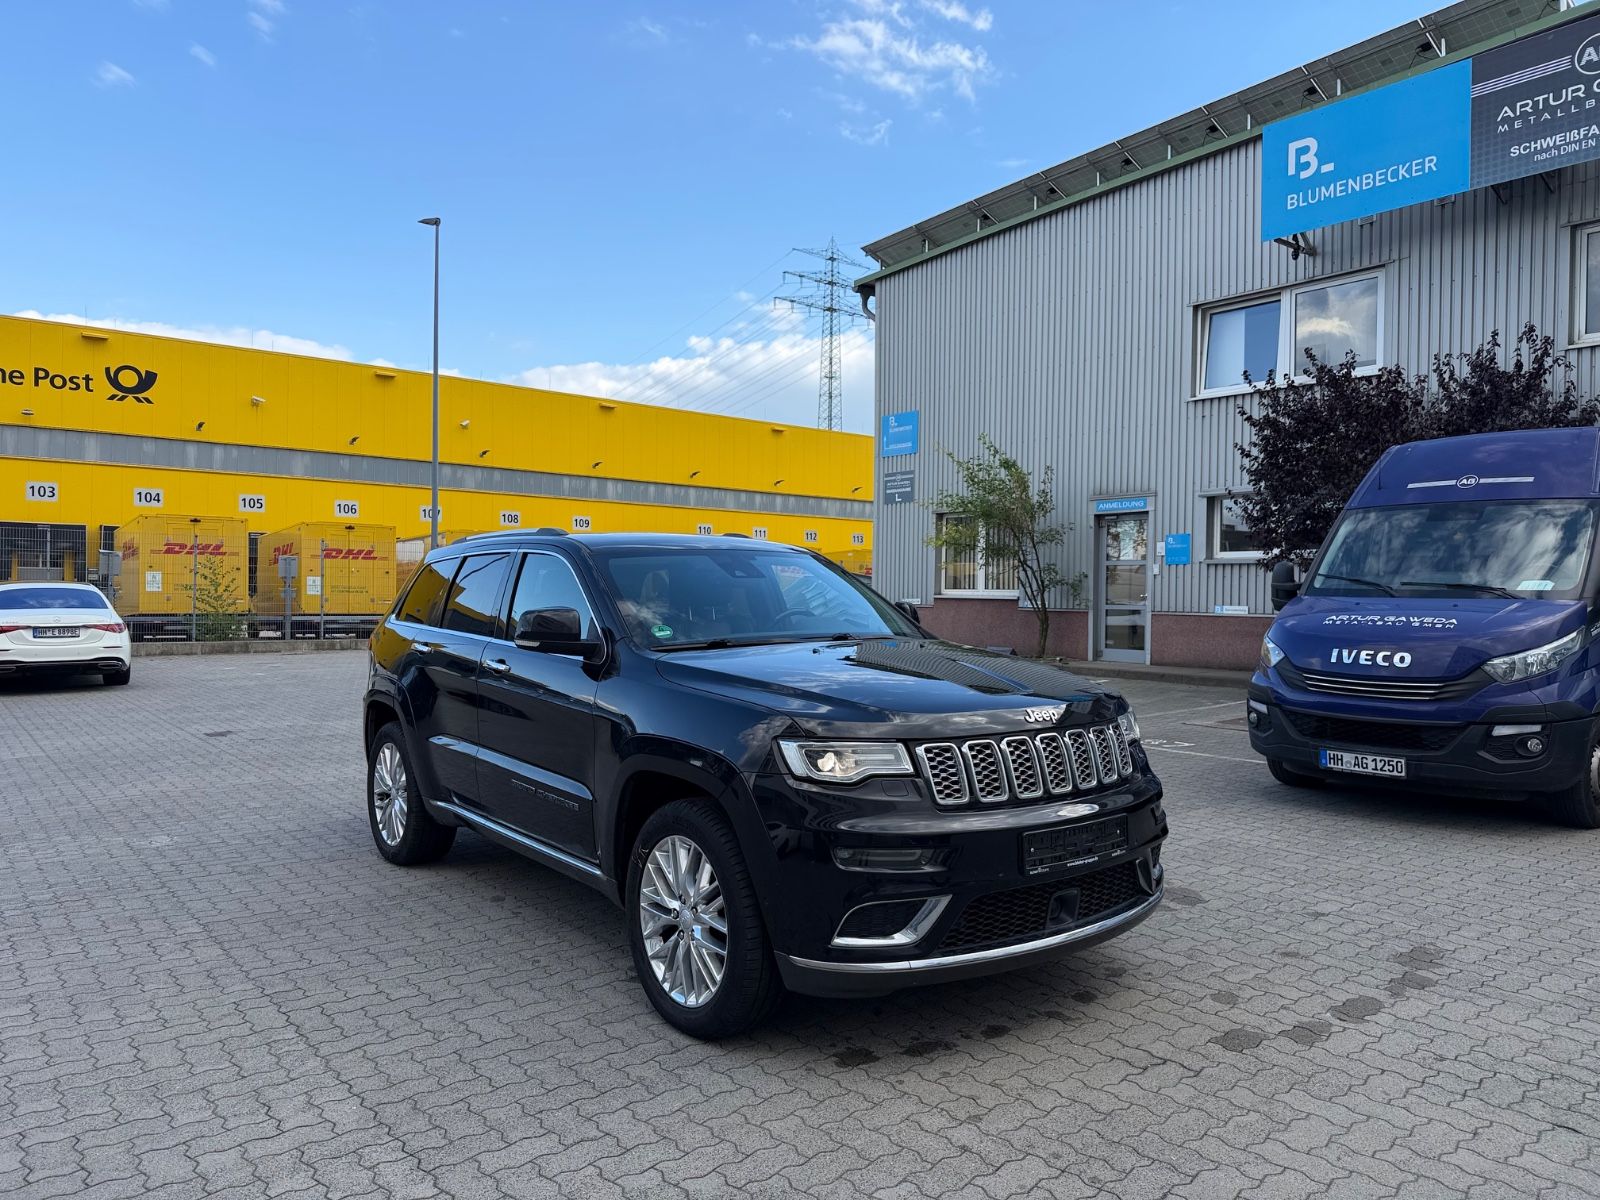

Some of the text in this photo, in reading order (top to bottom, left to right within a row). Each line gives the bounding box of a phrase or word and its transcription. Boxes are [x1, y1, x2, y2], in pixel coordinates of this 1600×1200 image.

[1580, 46, 1600, 67] A
[1496, 84, 1586, 122] ARTUR
[1497, 99, 1596, 134] METALLB
[1534, 138, 1596, 162] nach DIN EN
[1286, 155, 1438, 210] BLUMENBECKER
[33, 366, 94, 393] Post
[29, 485, 56, 498] 103
[137, 491, 161, 503] 104
[241, 498, 263, 509] 105
[337, 504, 357, 514] 106
[1098, 500, 1144, 510] ANMELDUNG
[501, 513, 519, 524] 108
[574, 518, 590, 528] 109
[698, 526, 712, 535] 110
[754, 529, 767, 538] 111
[805, 532, 817, 541] 112
[852, 535, 864, 544] 113
[162, 542, 227, 556] DHL
[322, 547, 378, 561] DHL
[1325, 614, 1381, 622] ARTUR
[1330, 648, 1412, 668] IVECO
[1025, 708, 1058, 723] Jeep
[1328, 752, 1404, 775] HH AG 1250
